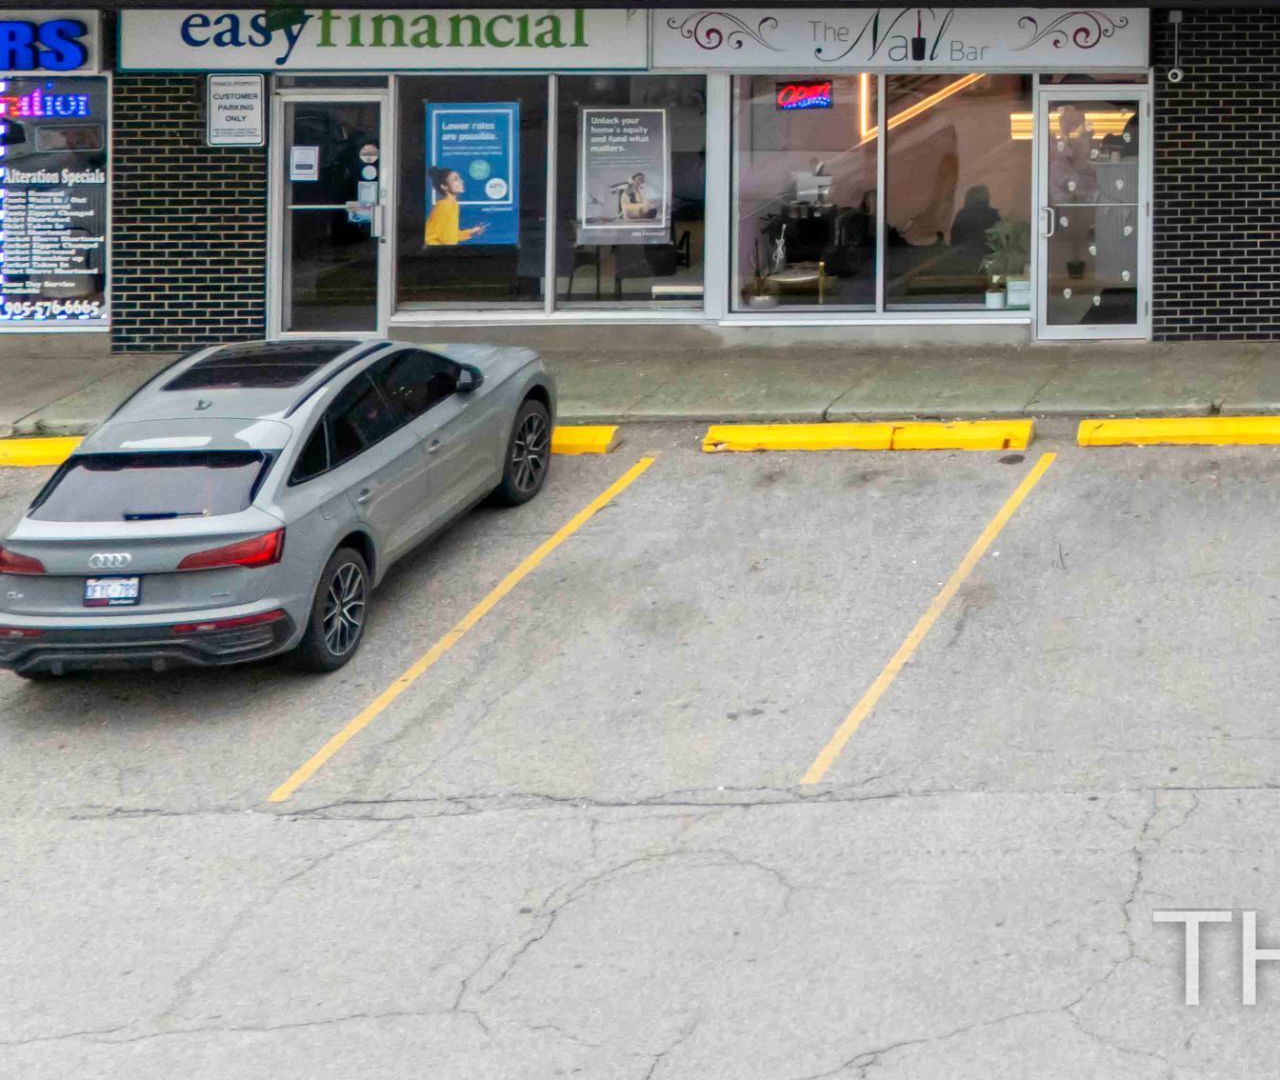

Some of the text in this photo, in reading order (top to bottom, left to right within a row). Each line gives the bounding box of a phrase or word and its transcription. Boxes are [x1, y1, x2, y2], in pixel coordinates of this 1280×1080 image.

[809, 21, 849, 42] The
[0, 19, 88, 71] RS
[950, 40, 989, 61] Bar
[212, 92, 259, 100] CUSTOMER
[591, 117, 640, 126] Unlock your
[622, 126, 649, 135] equity
[4, 168, 105, 187] Alteration Specials
[4, 300, 101, 317] 905-576-6665
